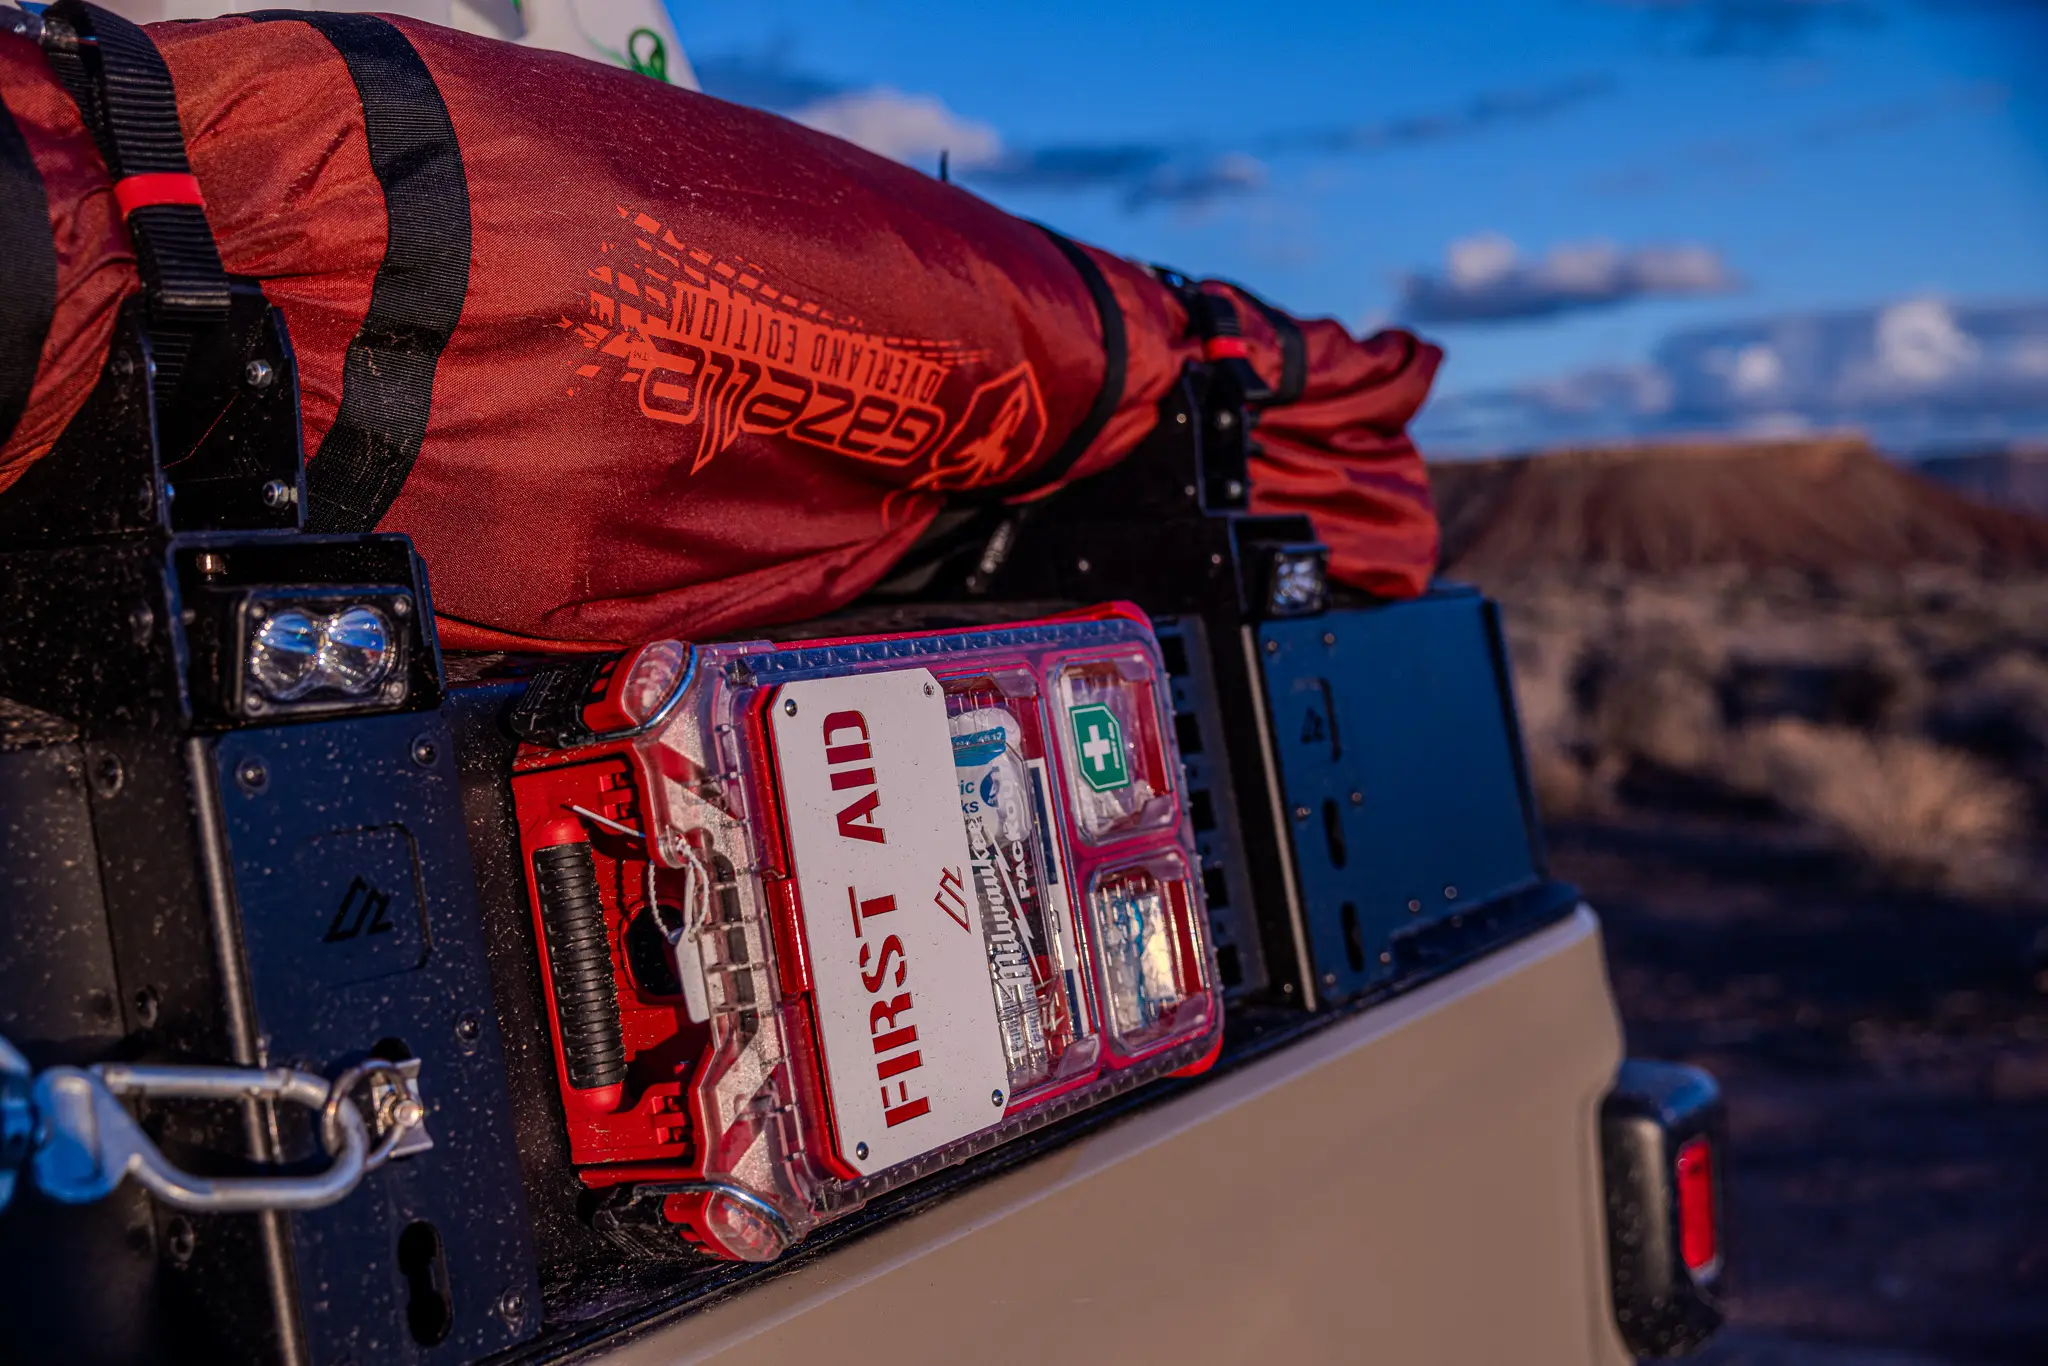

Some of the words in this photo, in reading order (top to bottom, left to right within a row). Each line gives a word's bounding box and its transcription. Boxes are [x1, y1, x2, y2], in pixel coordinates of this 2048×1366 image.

[674, 287, 799, 365] EDITION
[813, 335, 943, 404] OVERLAND
[822, 709, 888, 845] AID
[966, 819, 1034, 1000] Milwaukee
[848, 885, 932, 1128] FIRST
